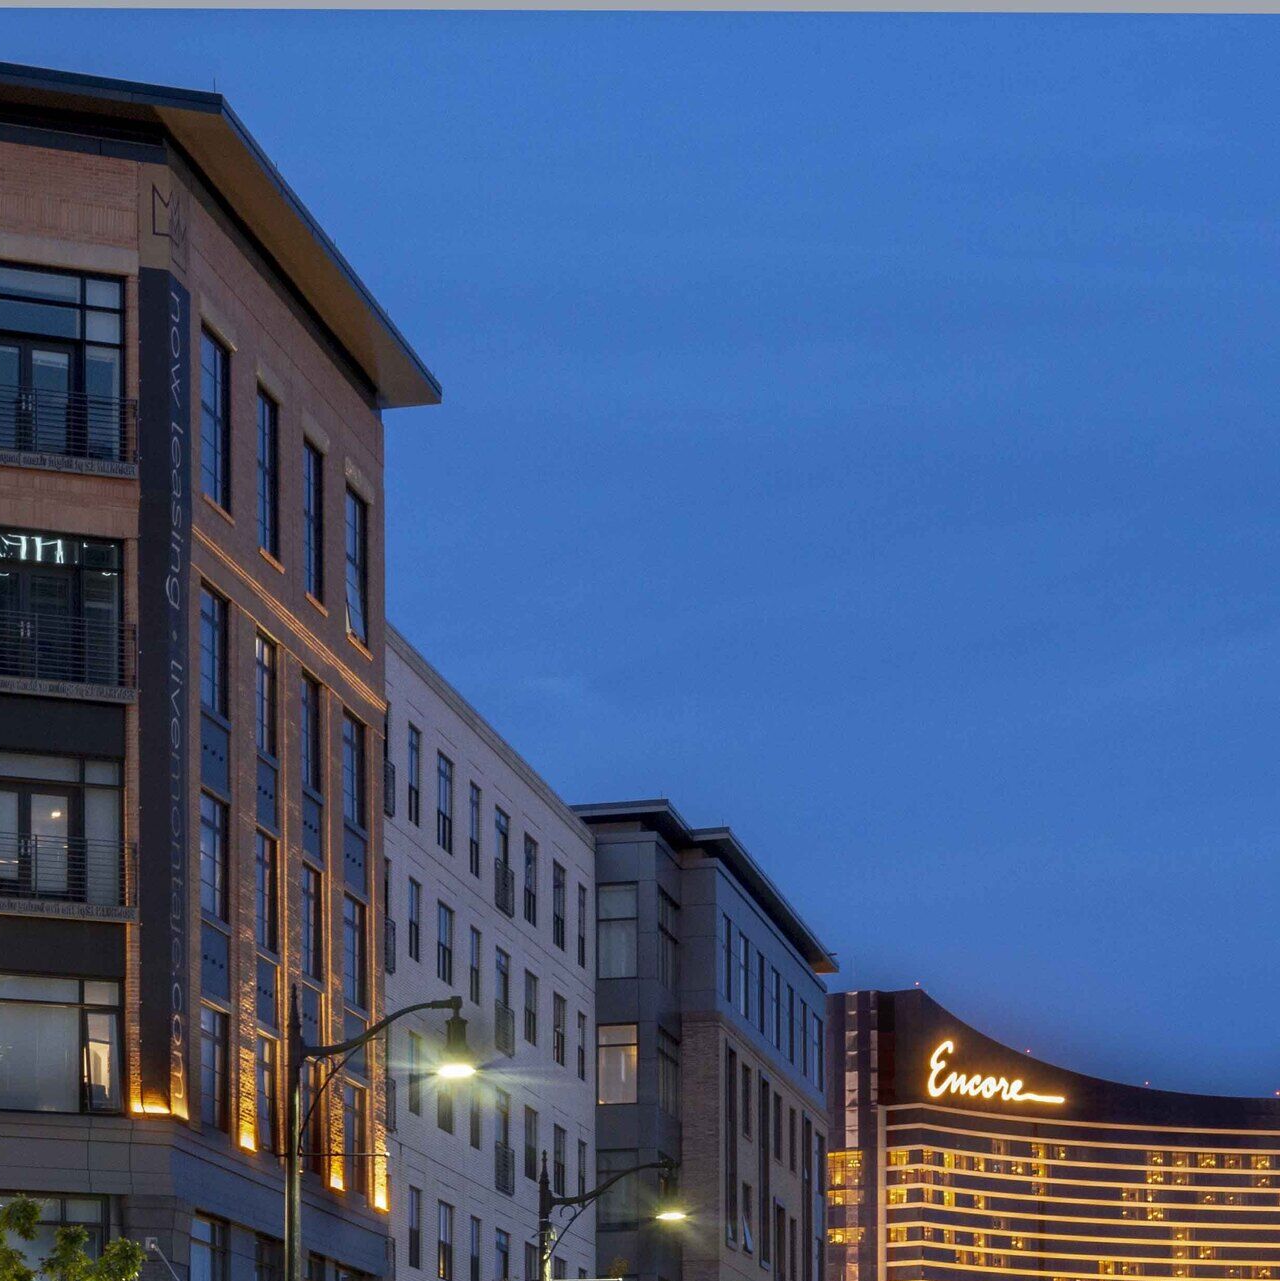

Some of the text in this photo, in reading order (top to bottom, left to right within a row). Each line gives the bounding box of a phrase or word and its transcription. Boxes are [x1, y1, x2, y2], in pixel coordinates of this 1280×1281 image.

[171, 292, 180, 408] now
[166, 422, 183, 610] leasing
[928, 1041, 1064, 1103] Encore
